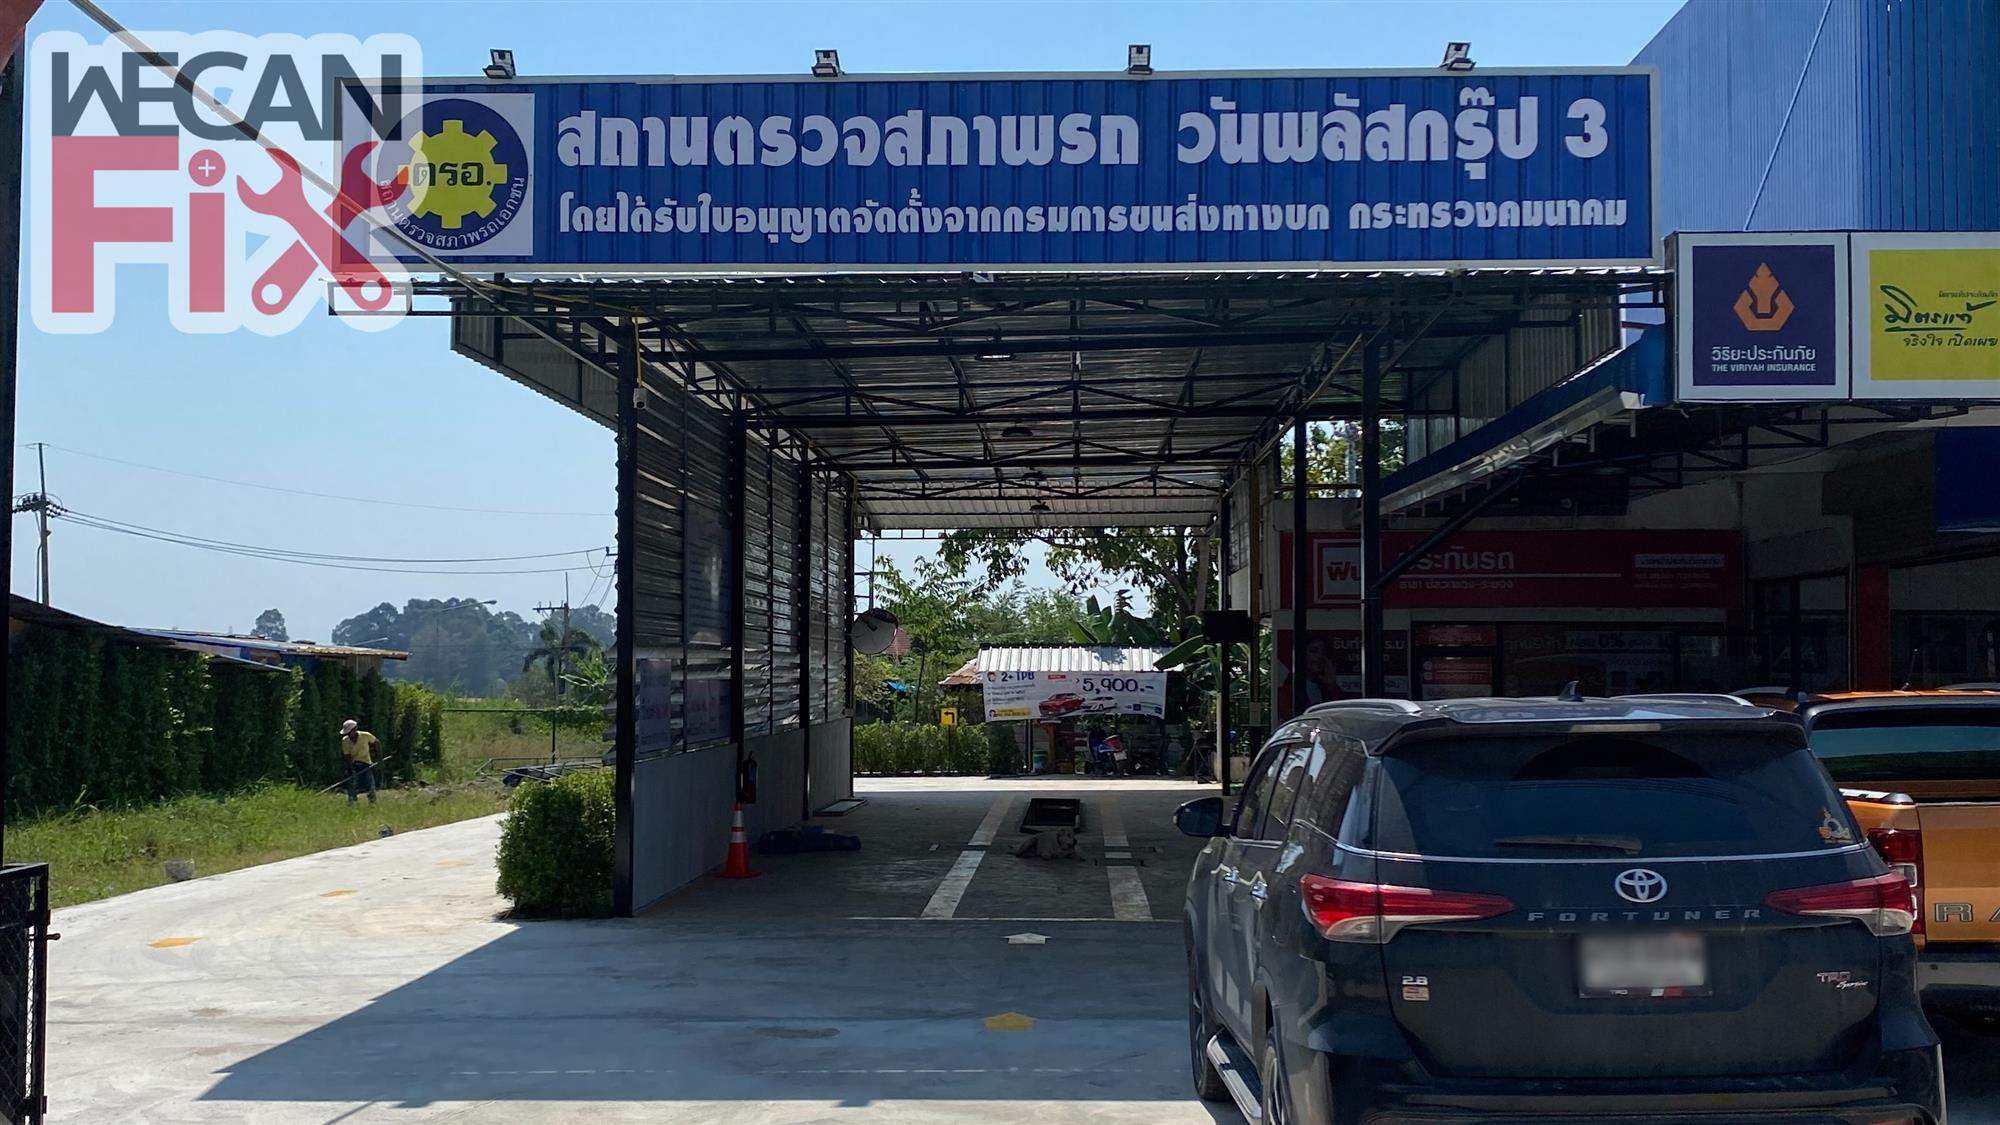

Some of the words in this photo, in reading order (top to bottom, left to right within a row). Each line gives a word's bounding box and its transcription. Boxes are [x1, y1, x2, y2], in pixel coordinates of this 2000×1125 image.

[557, 110, 1139, 167] สถานตรวจสภาพรถ
[1177, 86, 1539, 180] วันพลัสกรุ๊ป
[1565, 98, 1609, 159] 3
[413, 161, 492, 187] ตรอ.
[1349, 198, 1628, 230] กระทรวงคมนาคม
[1711, 344, 1817, 361] วิริยะประกันภัย
[1711, 364, 1728, 372] THE
[1730, 363, 1765, 372] VIRIYAH
[1767, 363, 1816, 372] INSURANCE
[1527, 908, 1762, 923] FORTUNER
[1934, 902, 2000, 923] R
